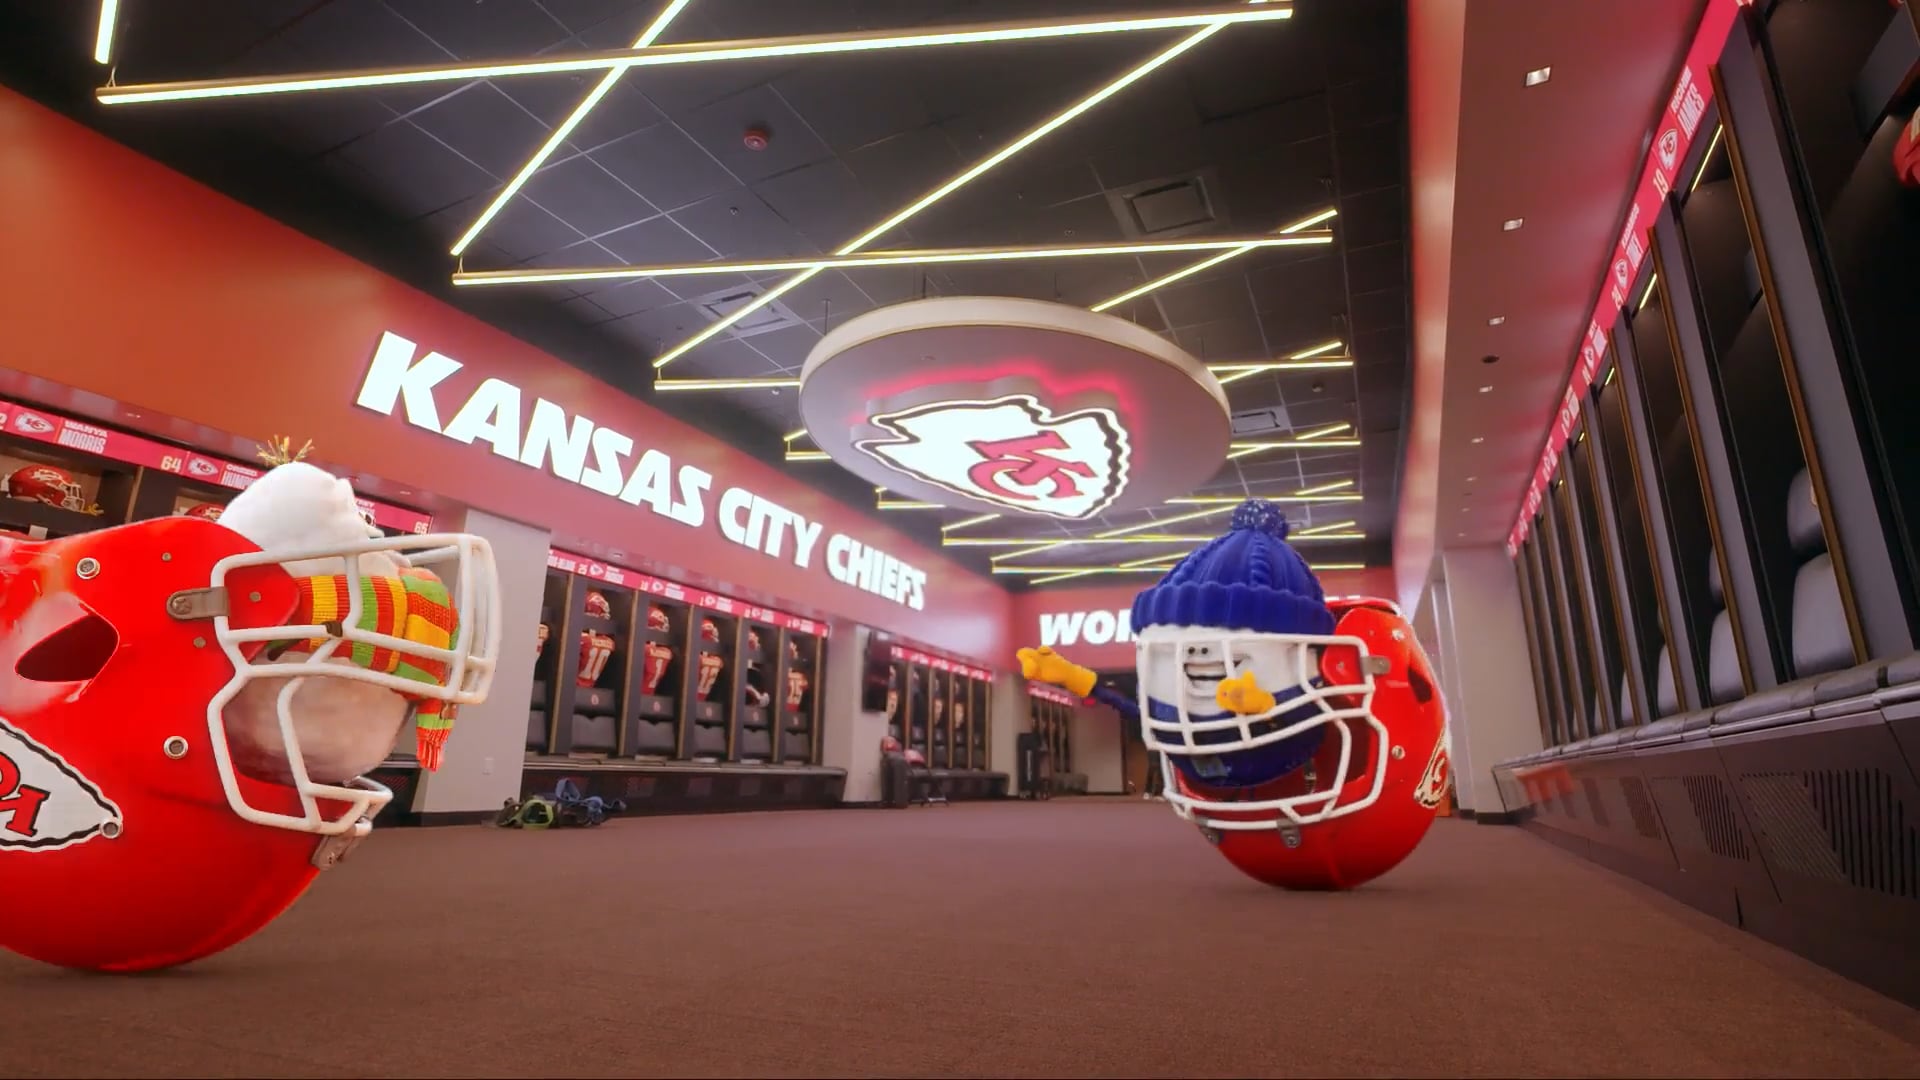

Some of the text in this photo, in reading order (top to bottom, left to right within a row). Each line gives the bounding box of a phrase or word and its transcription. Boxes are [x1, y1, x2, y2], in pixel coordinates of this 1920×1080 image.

[1676, 82, 1705, 141] JAMES
[57, 427, 107, 455] MORRIS
[160, 455, 182, 474] 64
[356, 330, 927, 611] KANSAS CITY CHIEFS
[414, 520, 429, 534] 65
